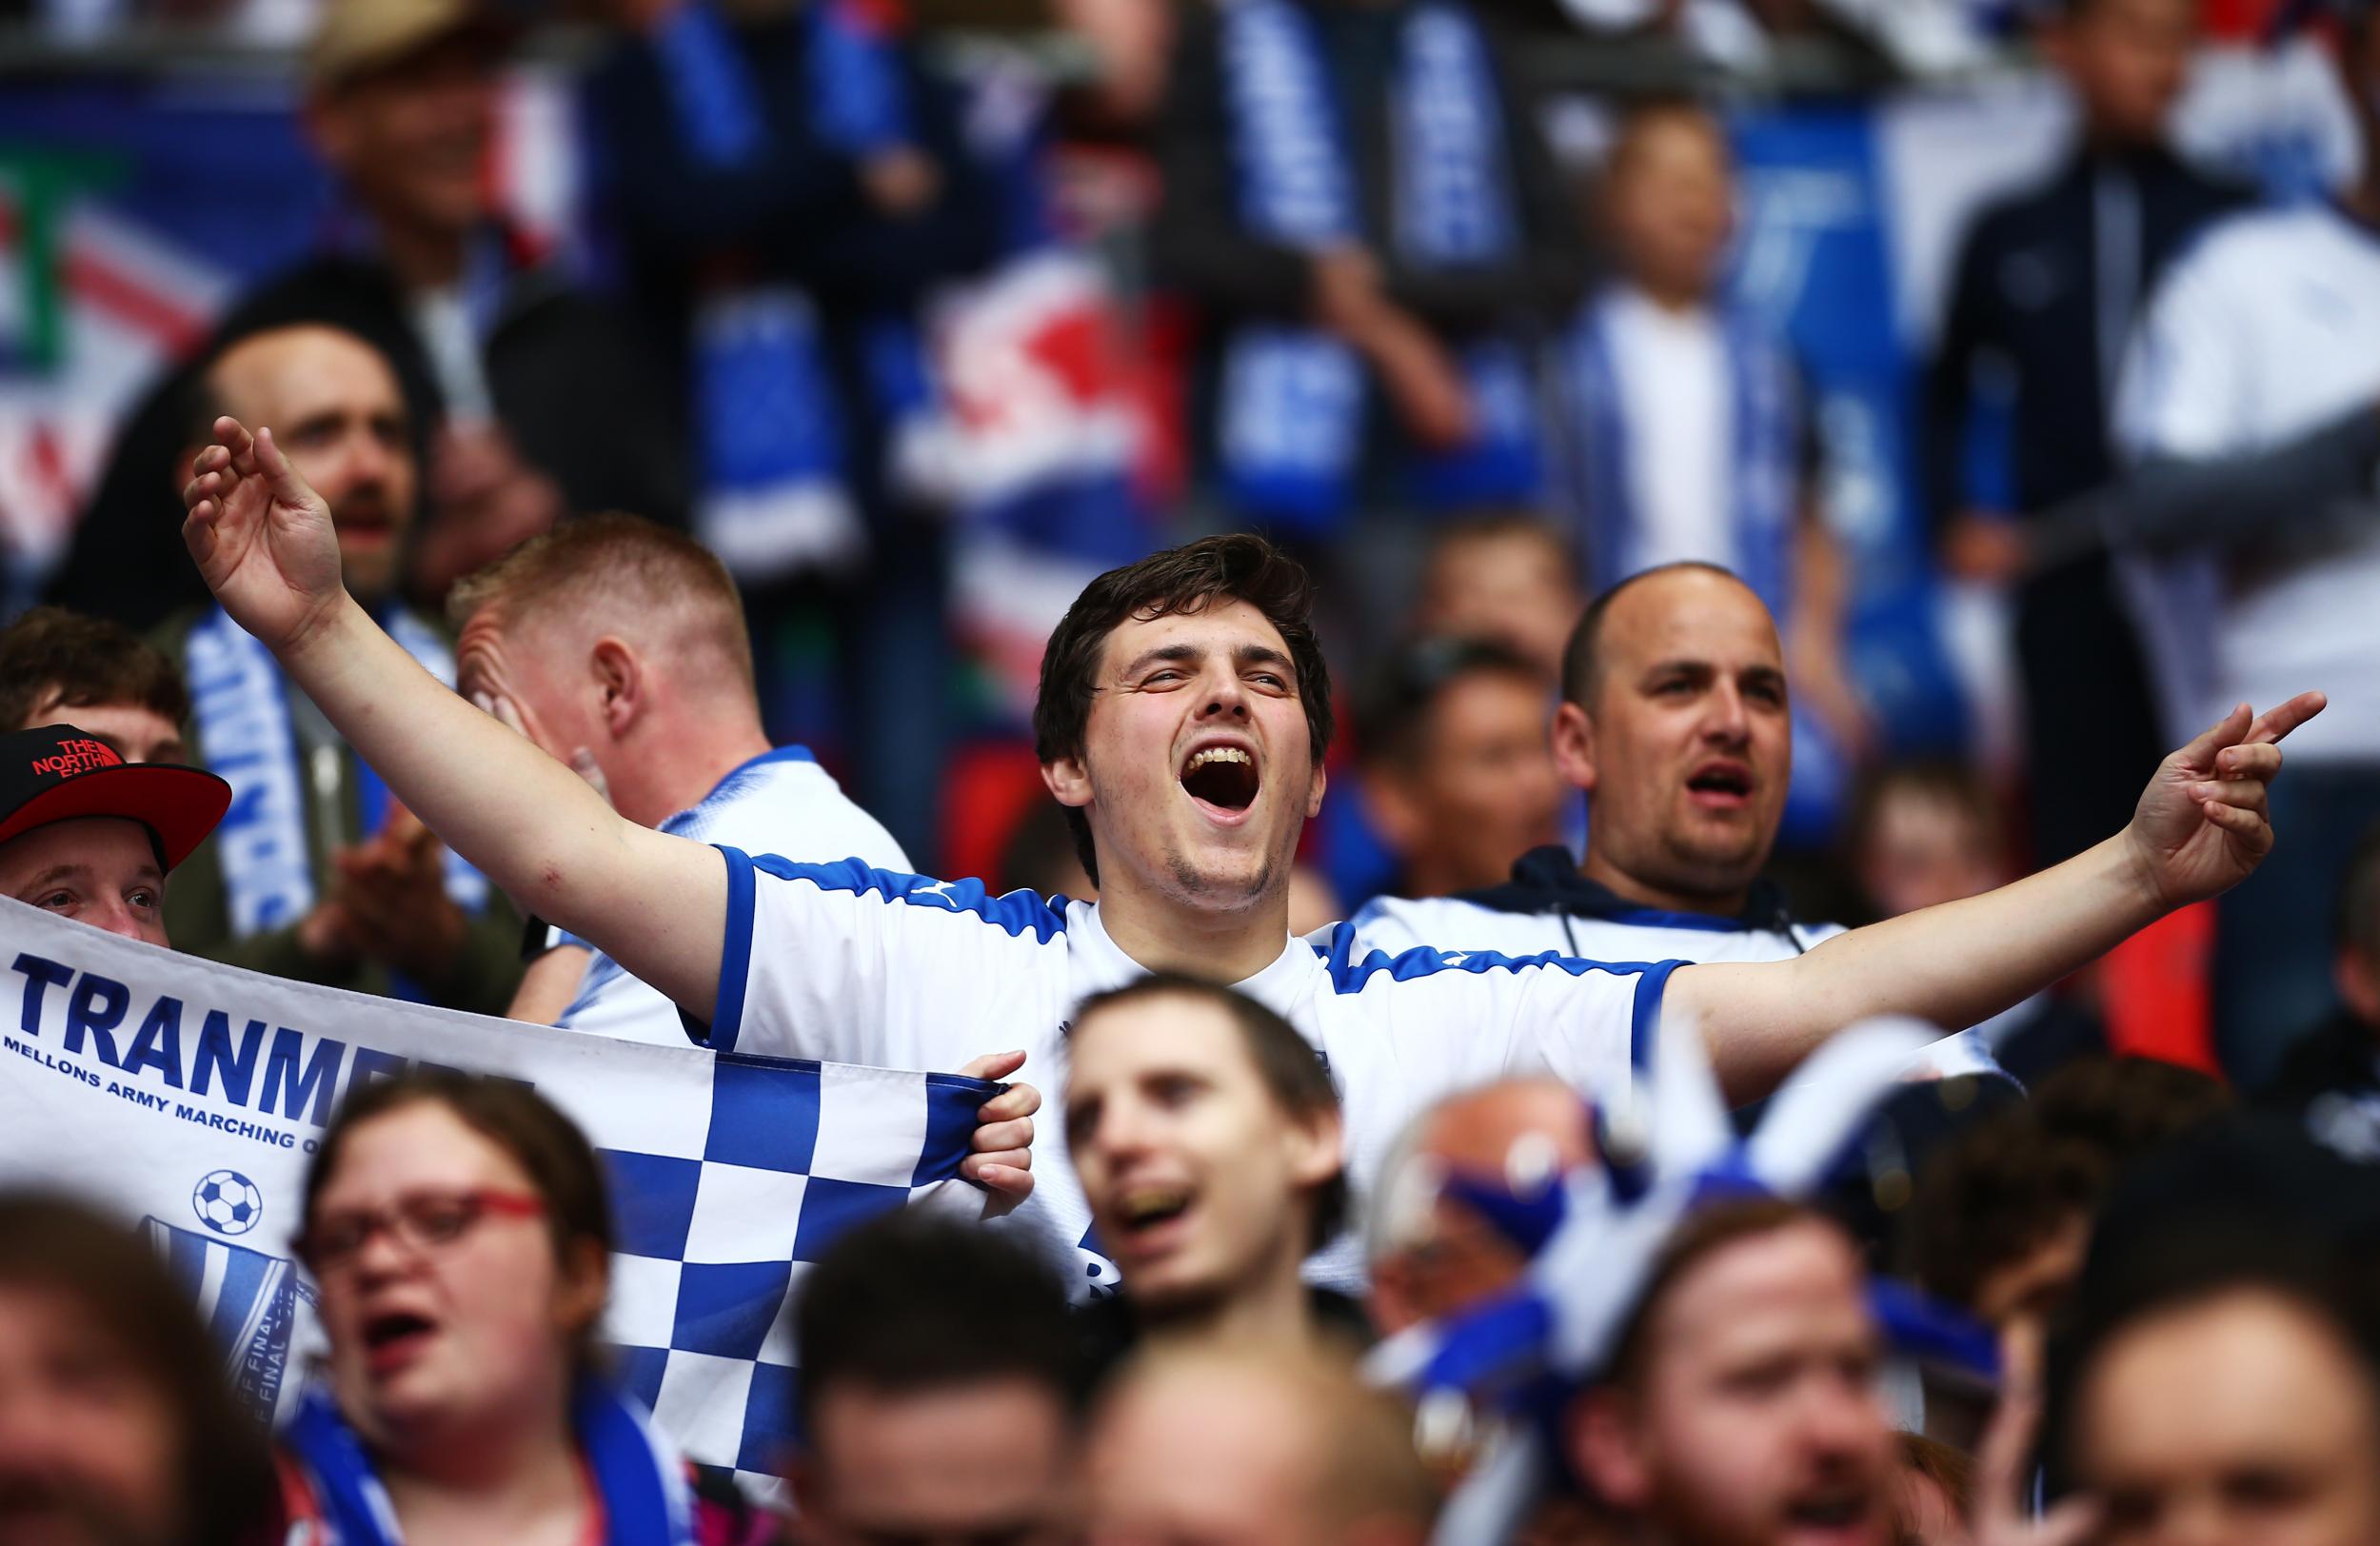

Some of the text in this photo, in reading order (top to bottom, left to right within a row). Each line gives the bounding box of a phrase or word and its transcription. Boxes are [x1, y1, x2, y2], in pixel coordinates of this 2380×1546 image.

[31, 752, 105, 776] NORTH
[56, 739, 99, 755] THE
[4, 1036, 101, 1088] MELLONS
[107, 1081, 169, 1112] ARMY
[175, 1103, 295, 1148] MARCHING
[258, 1340, 286, 1401] FINAL
